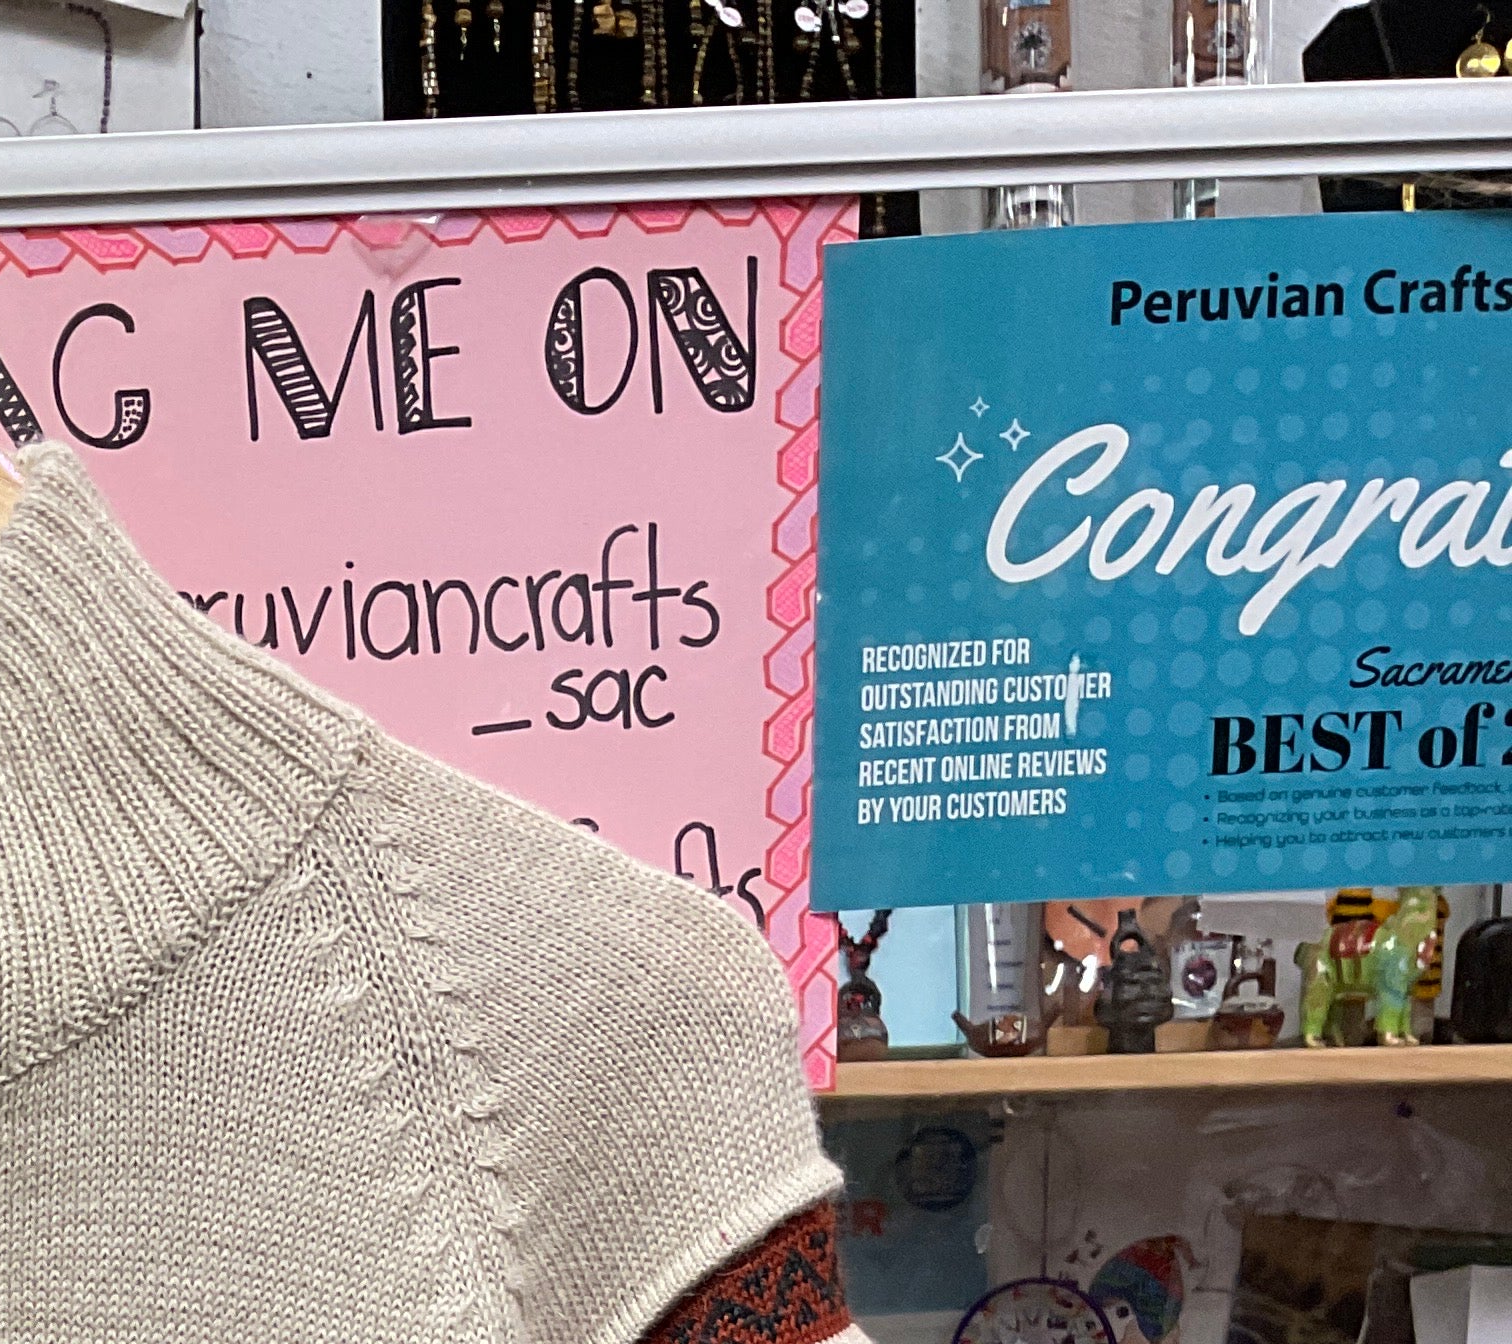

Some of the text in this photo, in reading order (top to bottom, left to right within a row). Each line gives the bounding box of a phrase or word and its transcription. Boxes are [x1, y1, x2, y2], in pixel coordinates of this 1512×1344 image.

[1110, 264, 1512, 326] Peruvian Crafts
[243, 276, 473, 443] ME
[543, 254, 759, 417] ON
[862, 637, 1030, 673] RECOGNIZED FOR
[1348, 645, 1512, 689] Sacrame
[860, 677, 998, 712] OUTSTANDING
[859, 712, 1060, 749] SATISFACTION FROM
[1206, 710, 1403, 777] BEST
[1418, 702, 1496, 769] of
[858, 748, 1108, 787] RECENT ONLINE REVIEWS
[857, 787, 1067, 825] BY YOUR CUSTOMERS
[1291, 786, 1352, 804] genuine
[1355, 783, 1429, 800] customer
[1313, 809, 1350, 824] your
[1353, 806, 1417, 820] business
[1215, 833, 1272, 849] Helping
[1275, 832, 1305, 847] you
[1308, 831, 1327, 843] to
[1330, 828, 1389, 843] attract
[1391, 827, 1424, 841] new
[1426, 826, 1506, 840] customers
